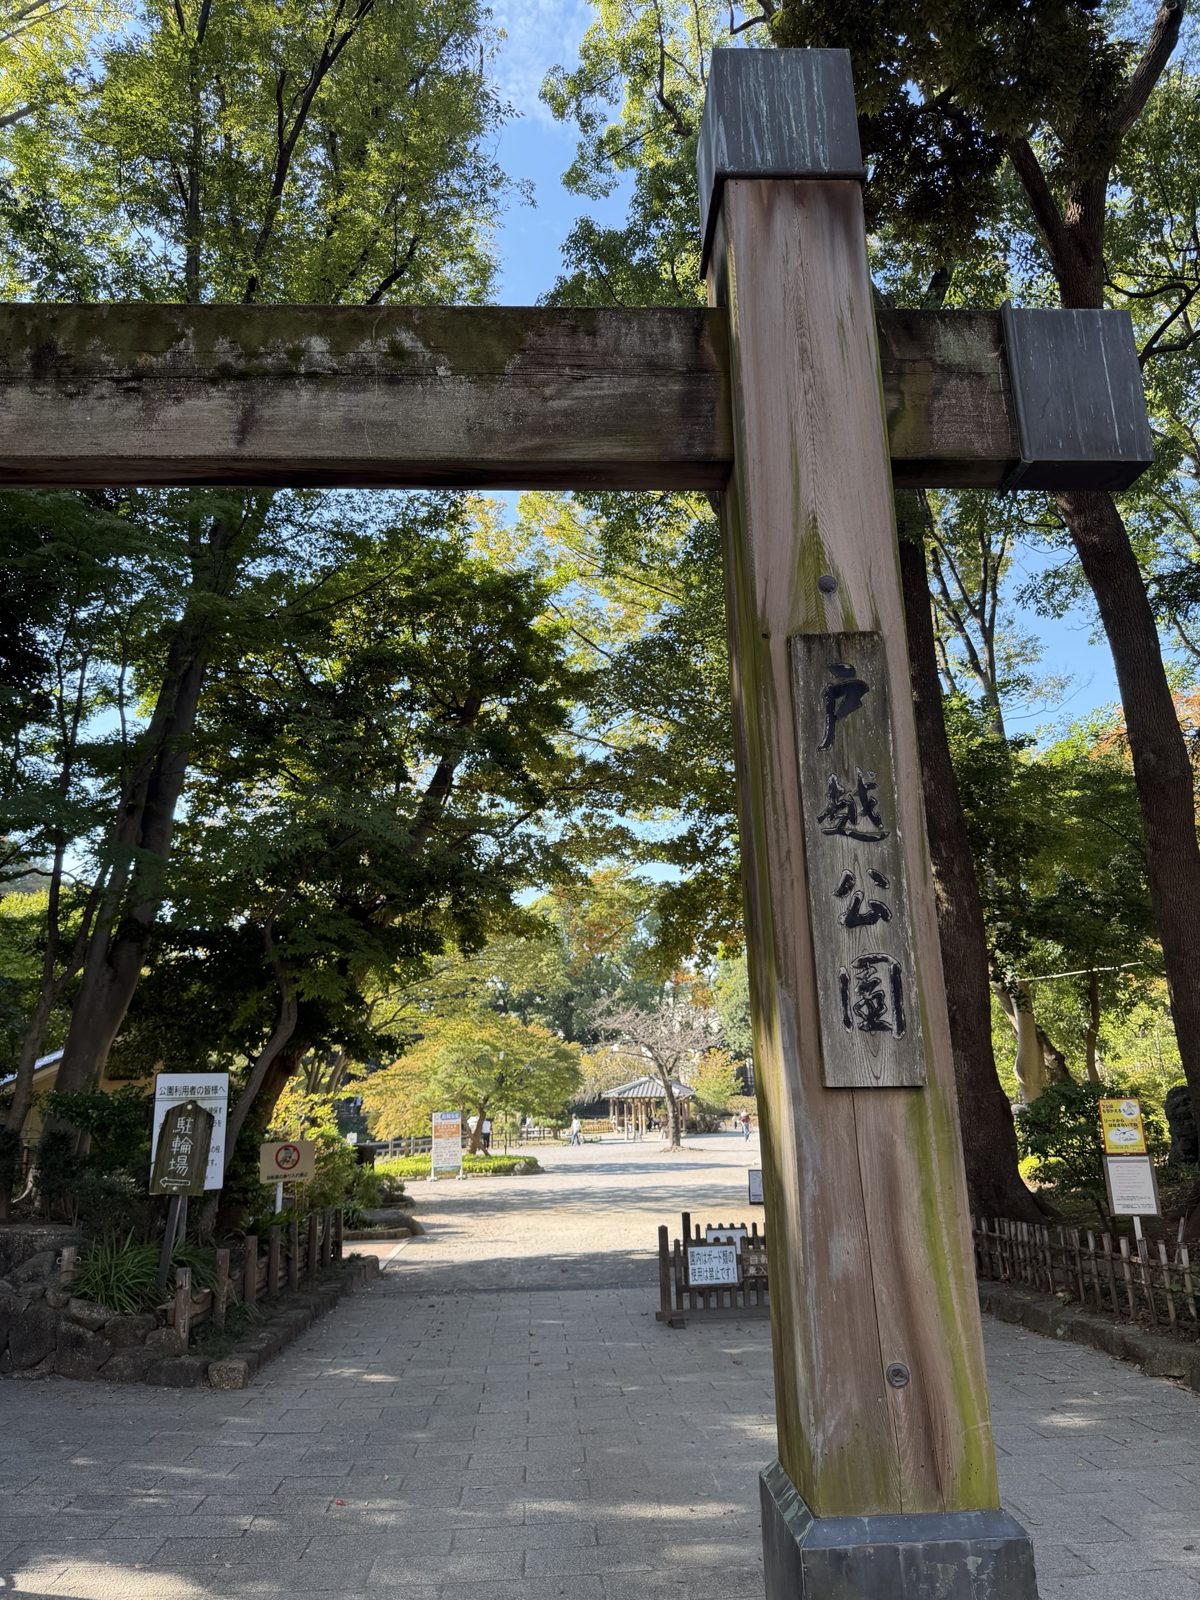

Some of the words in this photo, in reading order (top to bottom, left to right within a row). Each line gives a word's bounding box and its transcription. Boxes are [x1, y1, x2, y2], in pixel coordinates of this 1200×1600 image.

[816, 662, 907, 1040] 戸越公園
[159, 1085, 226, 1096] 公園利用者の皆様へ
[169, 1116, 194, 1177] 駐輪場
[689, 1250, 735, 1265] 園内はボード類の
